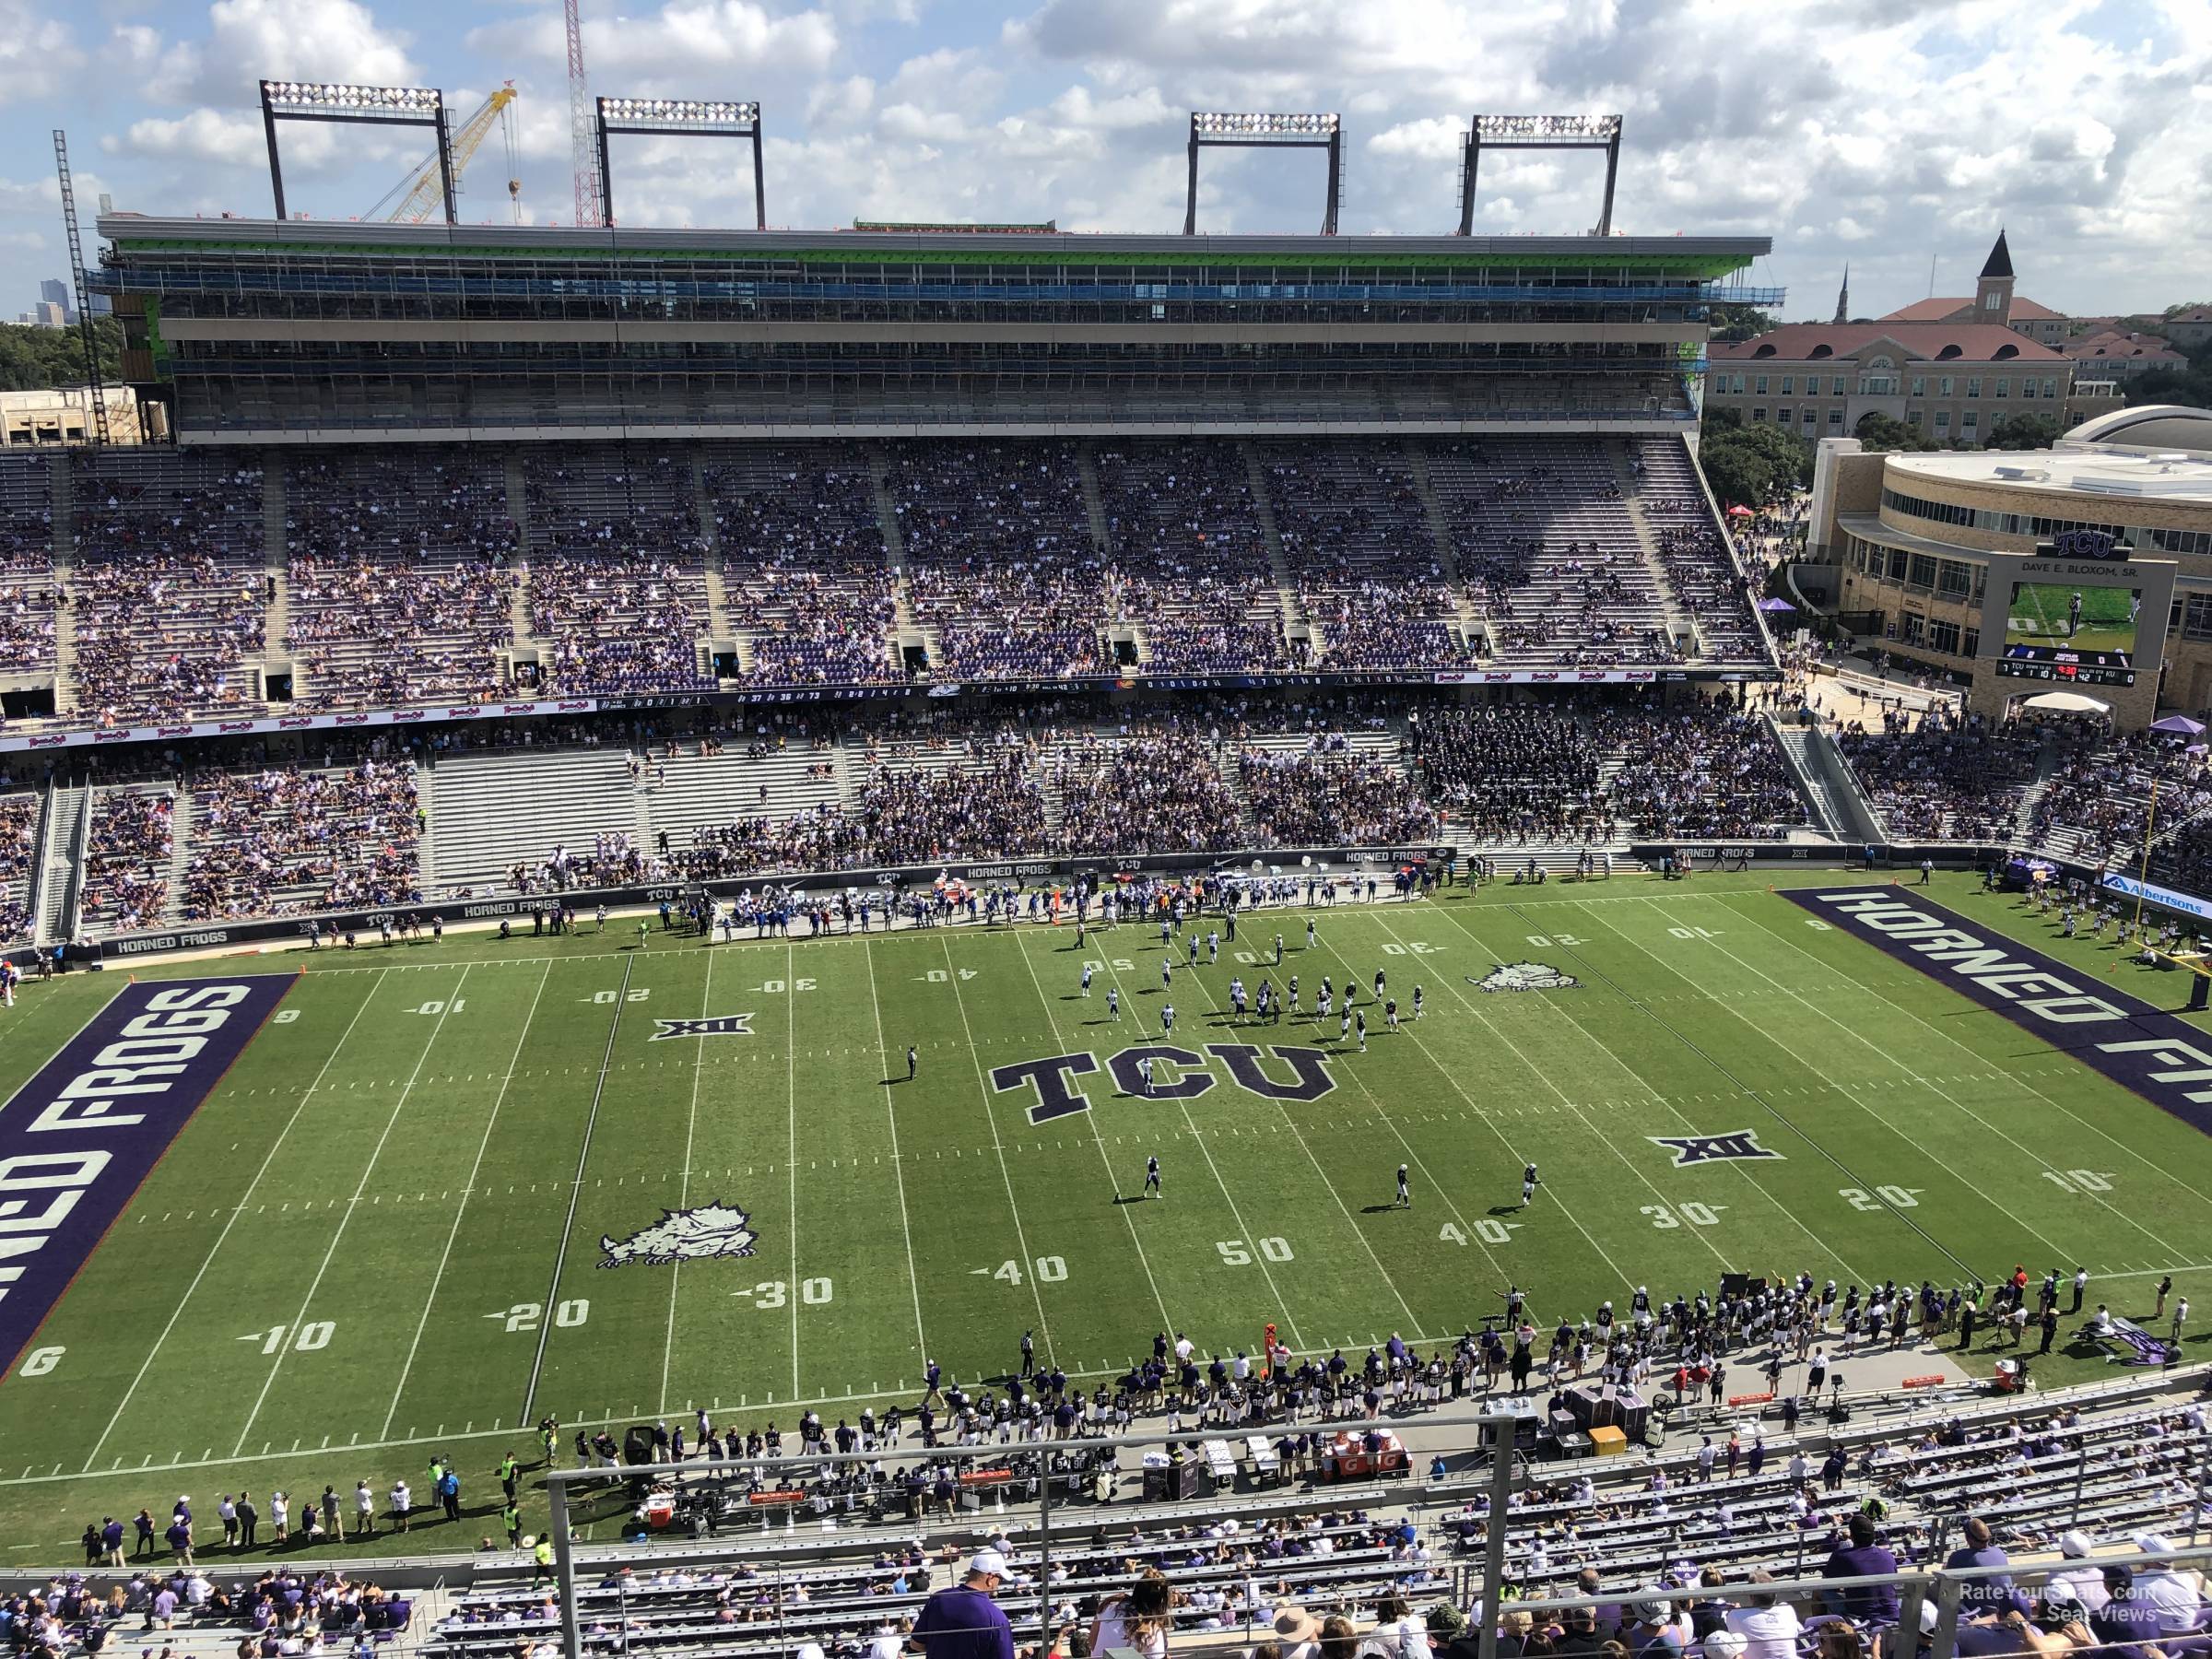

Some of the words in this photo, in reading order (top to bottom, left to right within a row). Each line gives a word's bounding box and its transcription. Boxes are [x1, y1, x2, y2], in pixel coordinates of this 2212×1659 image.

[2053, 530, 2117, 559] TCU
[2022, 562, 2050, 572] DAVE
[2054, 564, 2064, 573] E.
[2067, 565, 2118, 577] BLOXOM,
[2123, 568, 2138, 578] SR.
[2041, 670, 2049, 678] 10
[2127, 675, 2134, 683] 0
[2057, 665, 2077, 676] 9:30
[751, 694, 762, 702] 37
[1393, 851, 1429, 862] FROGS
[968, 865, 1013, 878] HORNED
[1117, 859, 1141, 871] TCU
[646, 889, 674, 901] TCU
[2129, 884, 2203, 913] Albertsons
[465, 901, 515, 918] HORNED
[1667, 926, 1713, 939] 10
[118, 936, 176, 955] HORNED
[181, 931, 228, 948] FROGS
[1525, 934, 1581, 947] 20
[1381, 942, 1436, 955] 30
[1816, 892, 2130, 1023] HORNED
[926, 968, 979, 982] 40
[762, 978, 818, 994] 30
[593, 988, 650, 1004] 20
[418, 1000, 466, 1015] 10
[26, 984, 252, 1133] FROGS
[988, 1042, 1338, 1126] TCU
[2041, 1169, 2115, 1194] 10
[1838, 1184, 1922, 1211] 20
[1639, 1202, 1720, 1230] 30
[1439, 1219, 1511, 1246] 40
[1216, 1237, 1295, 1266] 50
[994, 1255, 1070, 1287] 40
[755, 1277, 833, 1310] 30
[505, 1300, 590, 1333] 20
[262, 1321, 337, 1355] 10
[19, 1346, 67, 1378] G
[980, 1400, 992, 1411] 42
[1098, 1395, 1108, 1405] 34
[1118, 1400, 1126, 1408] 10
[1168, 1402, 1179, 1410] 35
[808, 1429, 818, 1438] 31
[1074, 1461, 1084, 1469] 90
[1345, 1459, 1357, 1471] G
[1384, 1455, 1396, 1466] G
[1017, 1466, 1029, 1476] 32
[857, 1476, 868, 1486] 20
[253, 1606, 268, 1618] 43
[86, 1630, 93, 1641] 5
